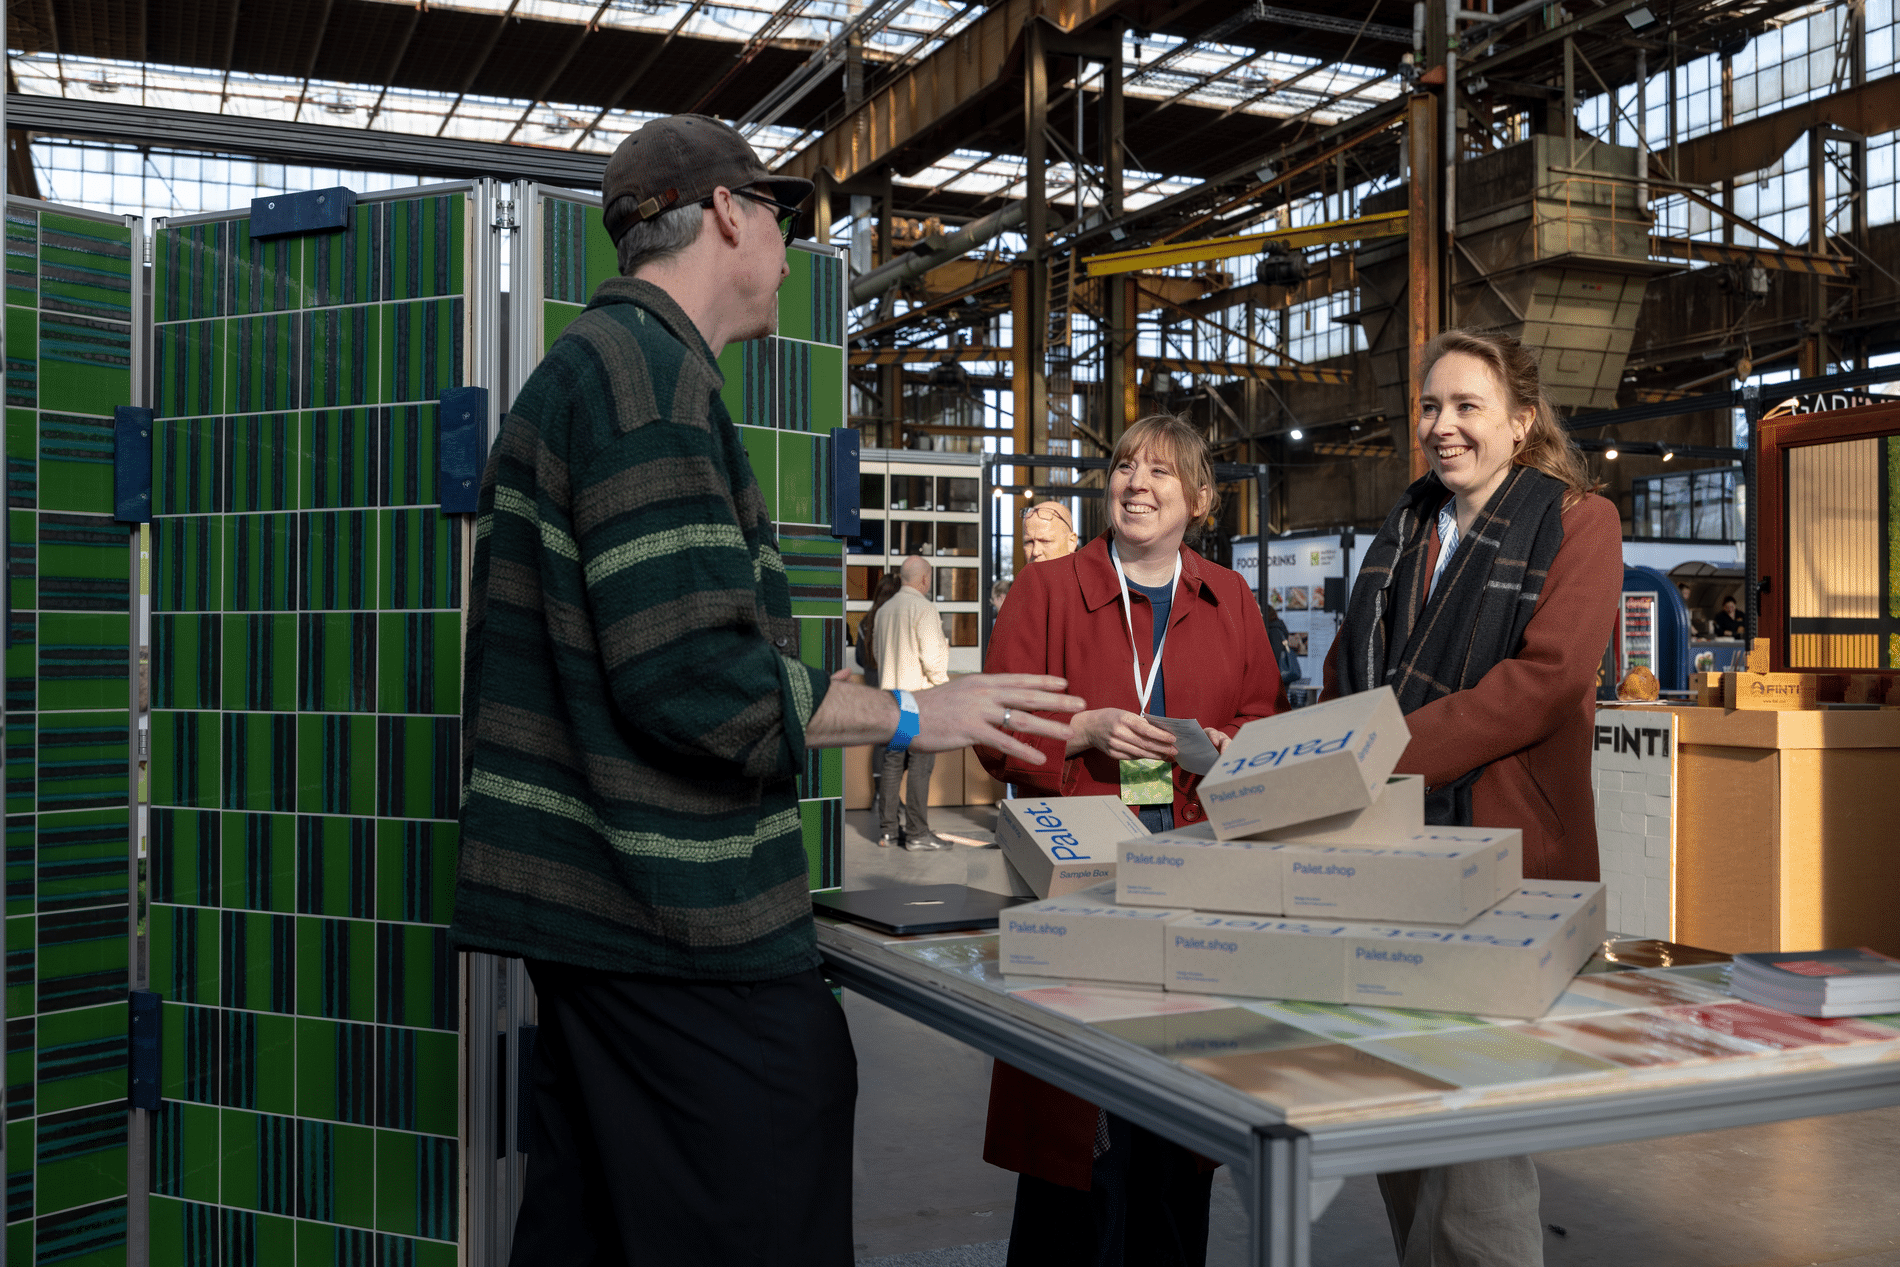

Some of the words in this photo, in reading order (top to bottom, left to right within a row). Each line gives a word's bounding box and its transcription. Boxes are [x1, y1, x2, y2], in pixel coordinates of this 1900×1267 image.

[1766, 684, 1800, 695] FINTI
[1593, 723, 1670, 759] FINTI
[1222, 729, 1354, 775] Palet.
[1209, 784, 1266, 804] Palet.shop
[1024, 802, 1091, 860] Palet.
[1126, 852, 1184, 867] Palet.shop
[1059, 869, 1091, 879] Sample
[1093, 869, 1109, 878] Box
[1292, 862, 1356, 877] Palet.shop
[1008, 920, 1067, 937] Palet.shop
[1175, 935, 1238, 954] Palet.shop
[1355, 946, 1424, 966] Palet.shop
